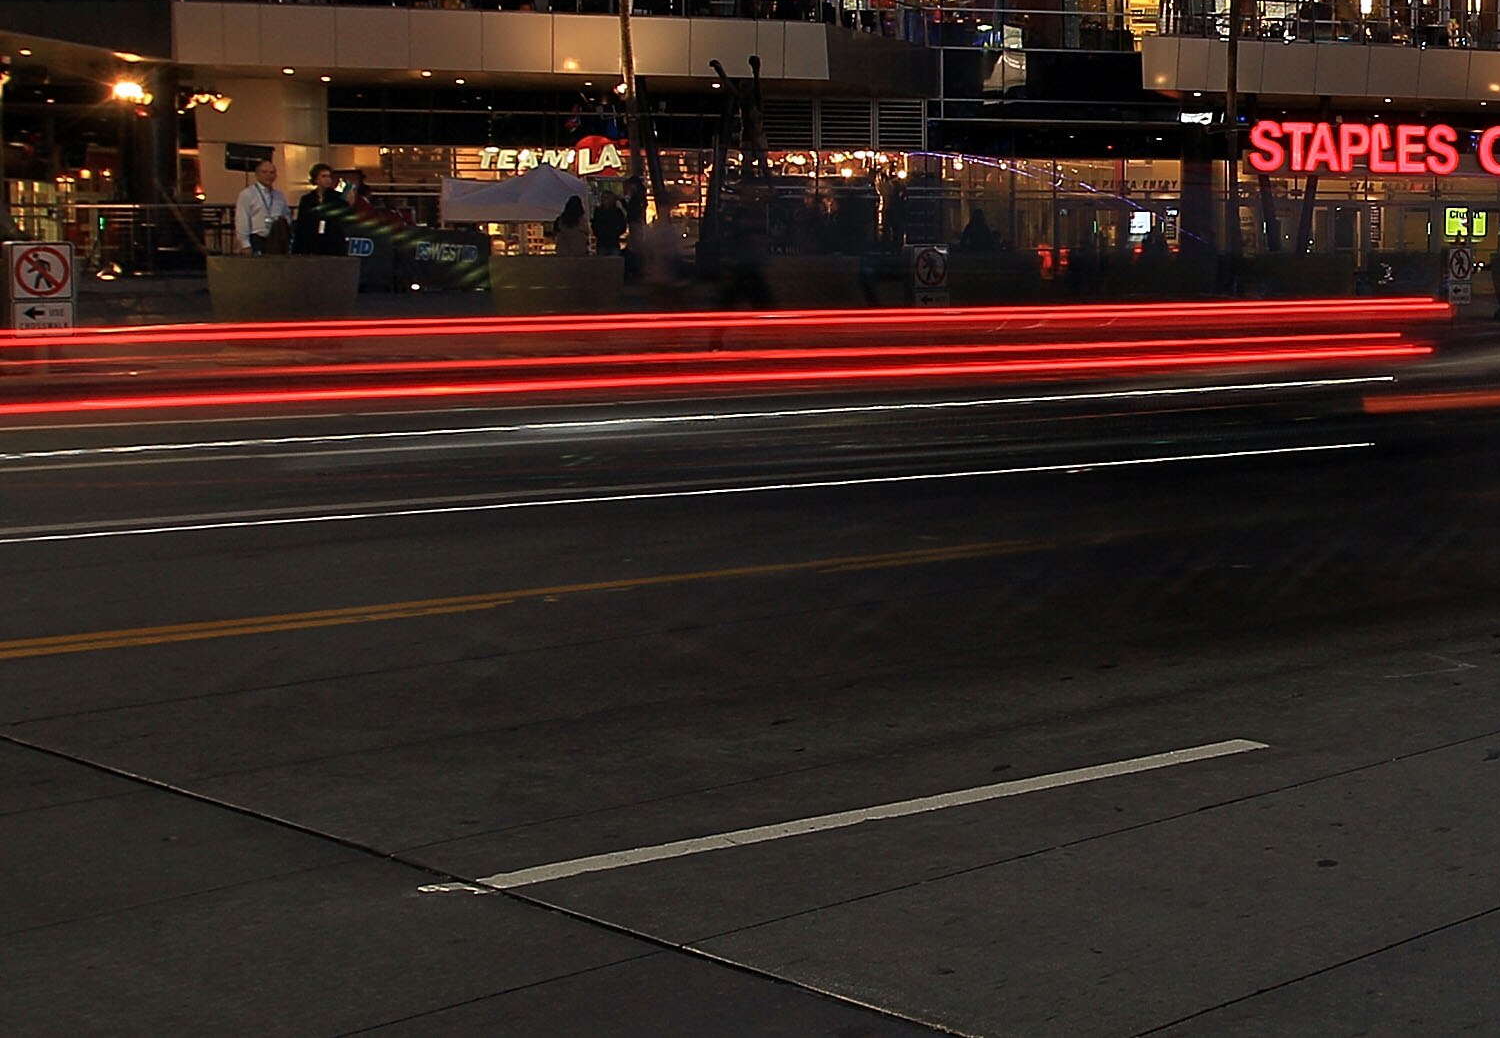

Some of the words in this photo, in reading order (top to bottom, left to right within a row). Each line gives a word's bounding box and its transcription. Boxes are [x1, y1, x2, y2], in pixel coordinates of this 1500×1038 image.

[478, 146, 574, 170] TEAM
[577, 143, 622, 175] LA
[1248, 120, 1459, 175] STAPLES
[1143, 179, 1177, 189] ENTRY
